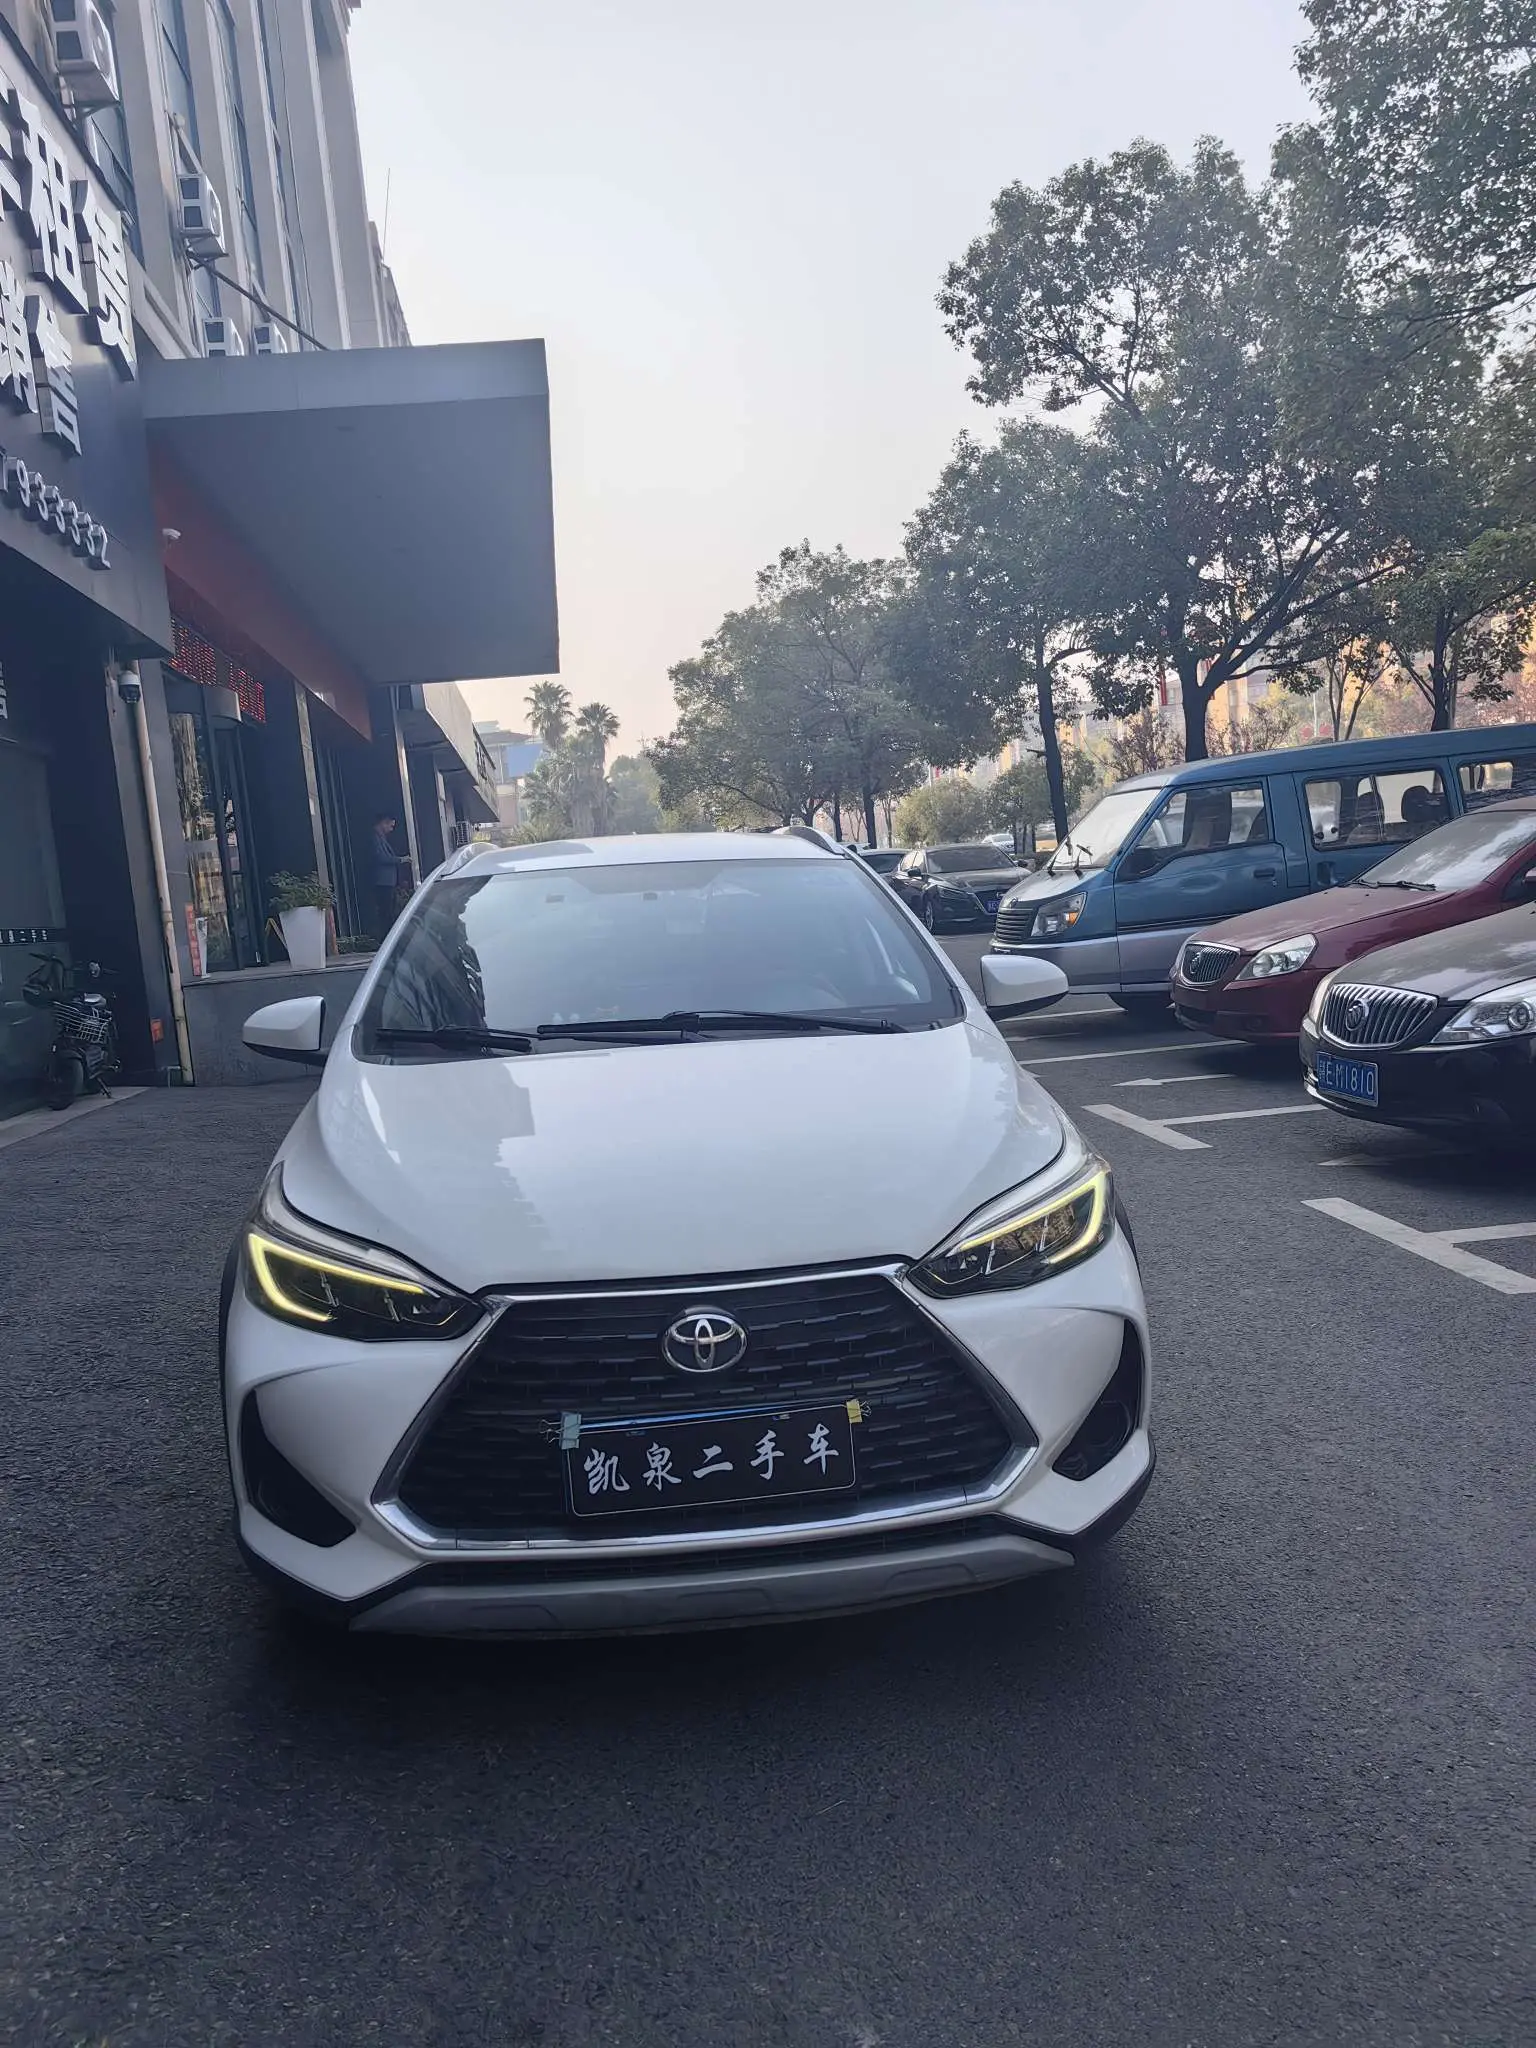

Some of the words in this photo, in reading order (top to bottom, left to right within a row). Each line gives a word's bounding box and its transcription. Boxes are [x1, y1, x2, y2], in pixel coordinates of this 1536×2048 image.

[583, 1423, 839, 1494] 凯泉二手车
